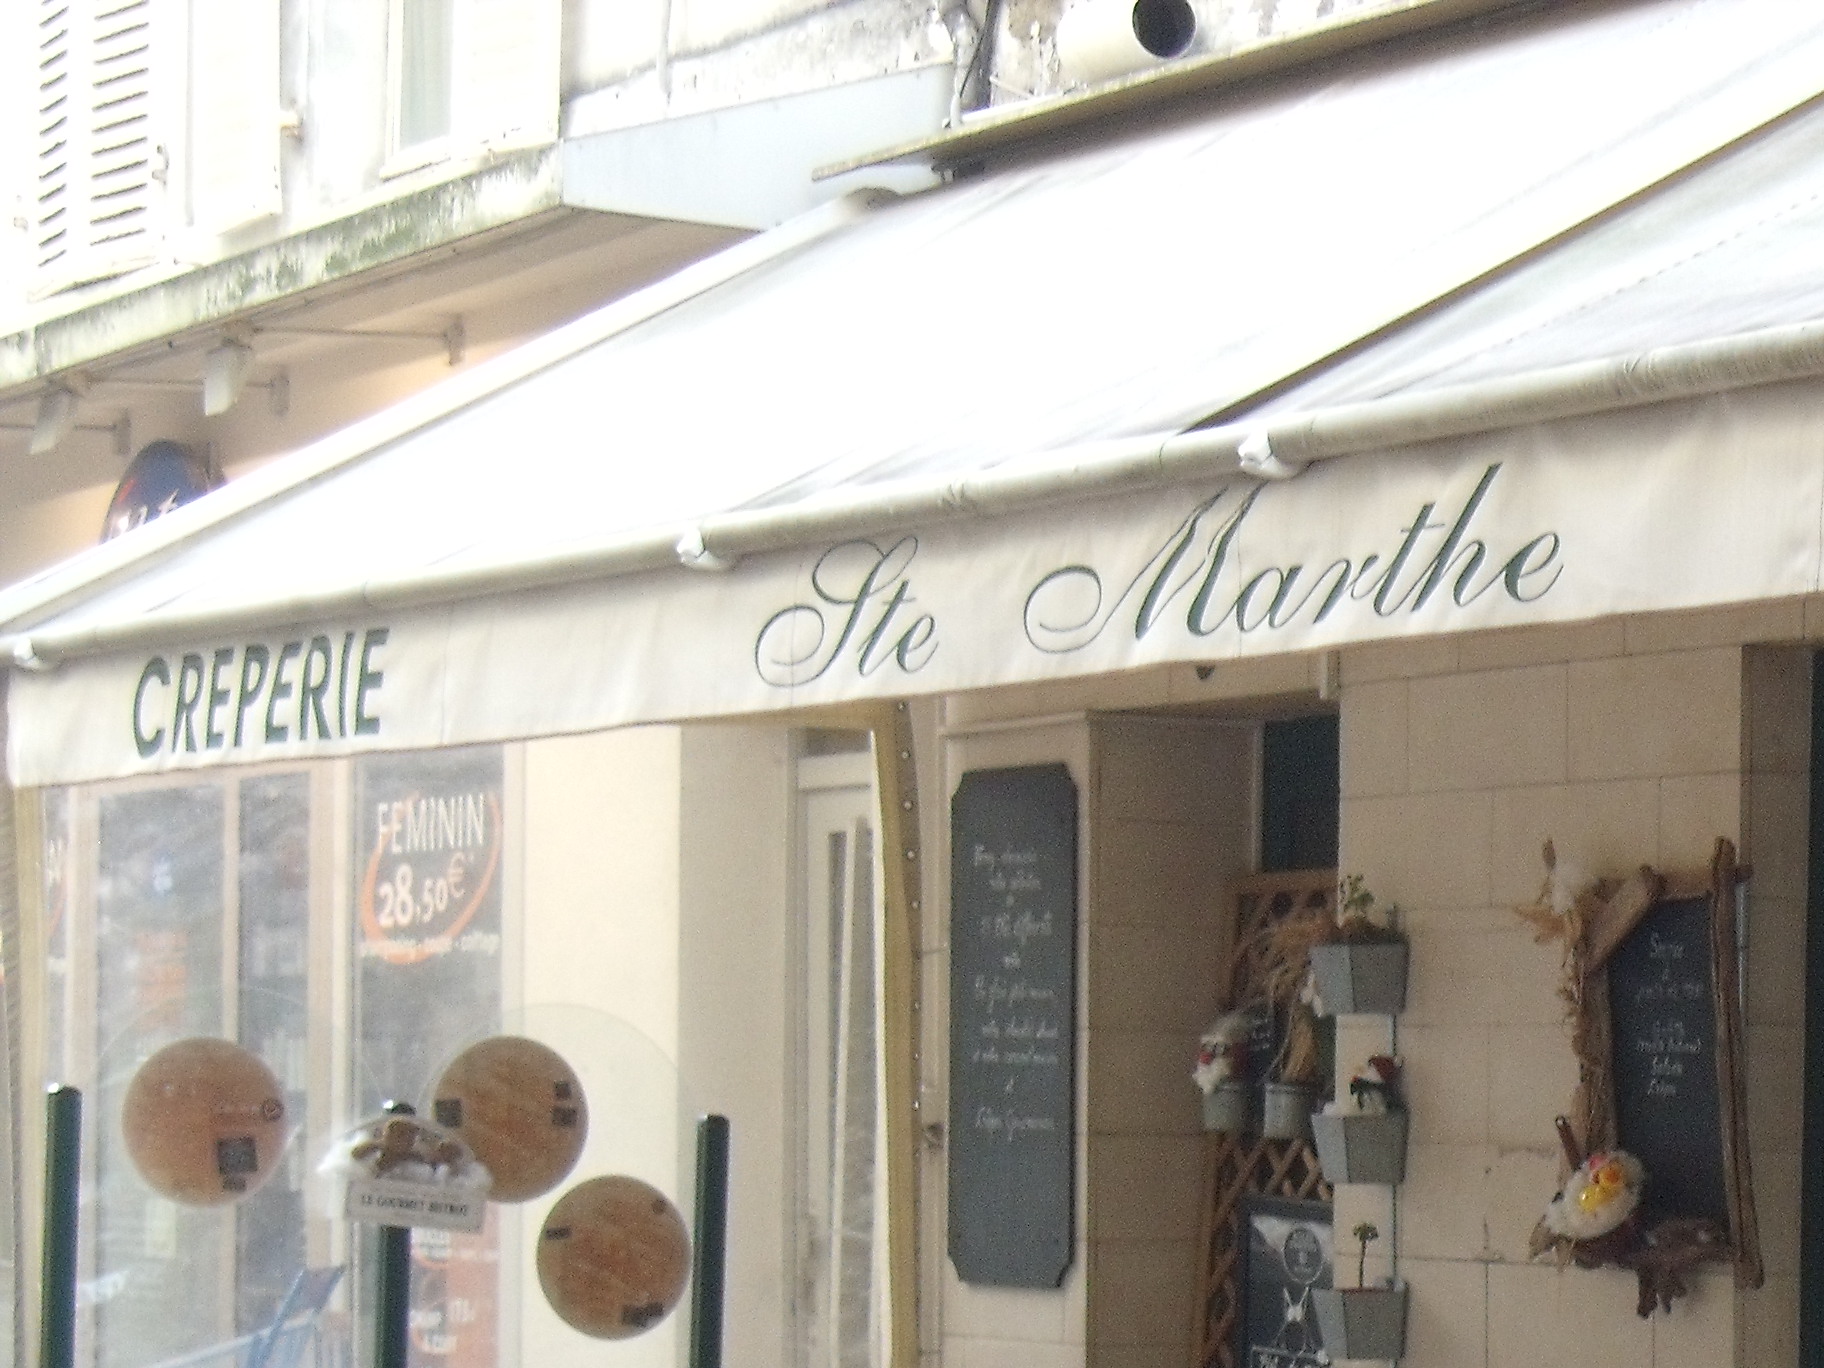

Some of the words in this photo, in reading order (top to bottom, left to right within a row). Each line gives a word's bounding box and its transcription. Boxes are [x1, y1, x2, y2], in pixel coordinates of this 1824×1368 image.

[755, 535, 940, 688] Ste
[1023, 461, 1565, 655] Marthe
[132, 627, 390, 760] CREPERIE
